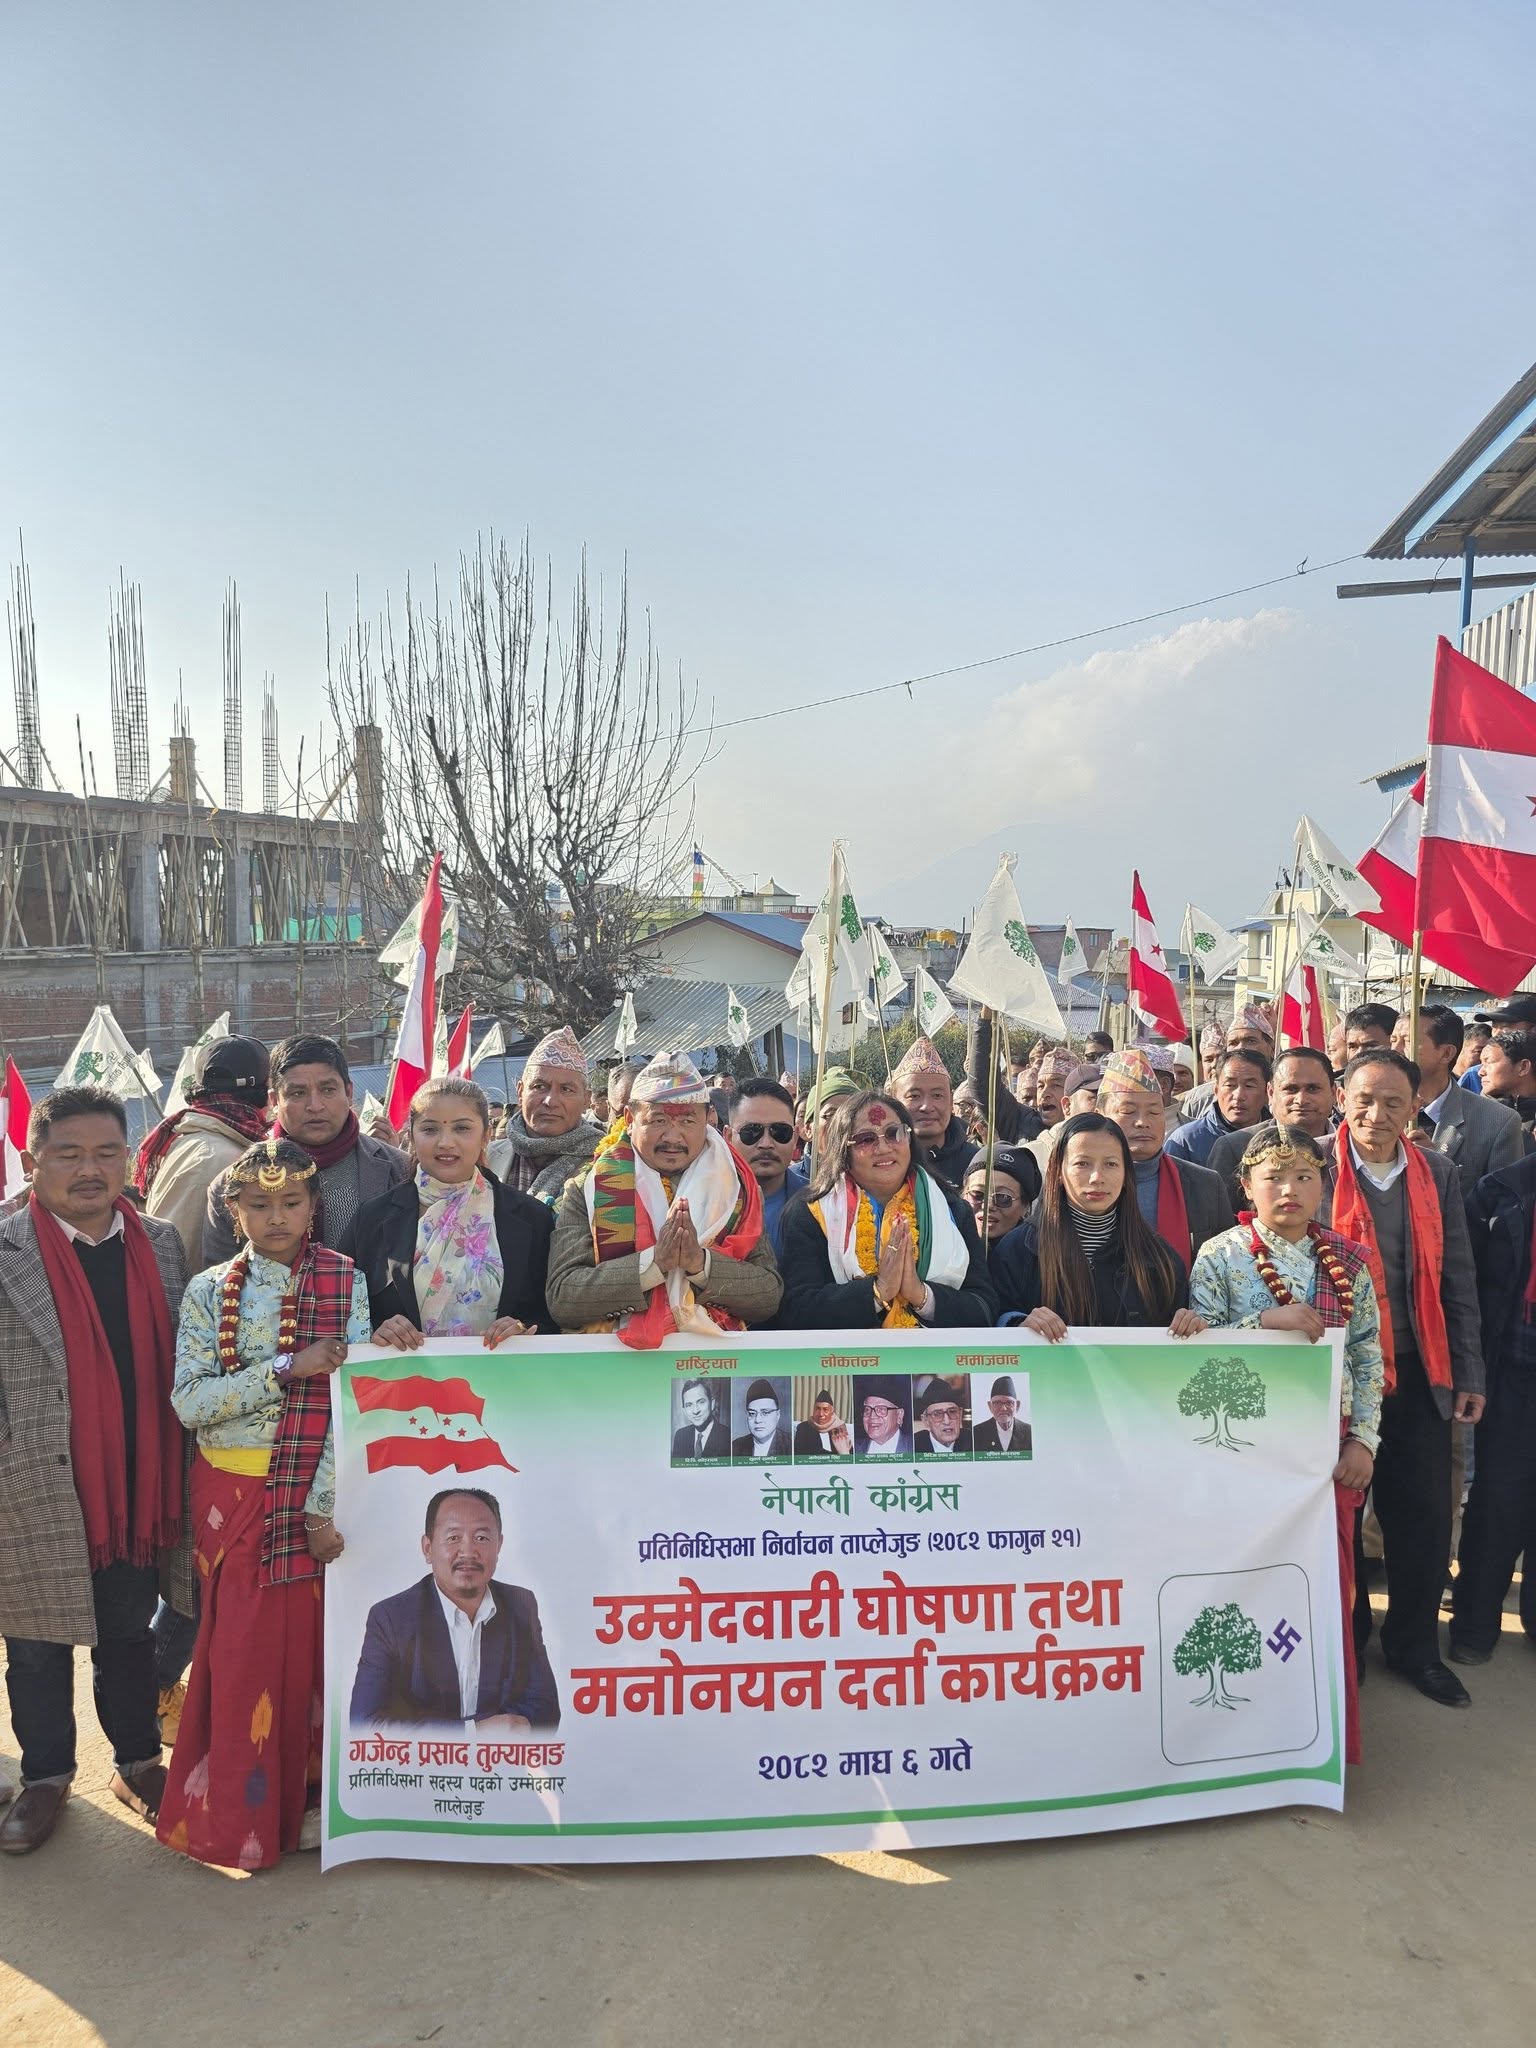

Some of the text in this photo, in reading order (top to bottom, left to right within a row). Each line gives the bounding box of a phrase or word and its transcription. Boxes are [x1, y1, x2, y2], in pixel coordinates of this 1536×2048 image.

[675, 1355, 738, 1376] राष्ट्रियता
[820, 1354, 881, 1368] लोकतन्त्र
[955, 1353, 1020, 1367] समाजवाद
[759, 1469, 963, 1517] नेपाली कांग्रेस
[638, 1527, 1081, 1564] प्रतिनिधिसभा निर्वाचन ताप्लेजुङ (२०८२ फागुन २१)
[592, 1570, 1124, 1645] उम्मेदवारी घोषणा तथा
[570, 1632, 1145, 1718] मनोनयन दर्ता कार्यक्रम
[349, 1732, 566, 1773] गजेन्द्र प्रसाद तुम्याहाङ
[758, 1737, 974, 1781] २०८२ माघ ६ गते
[348, 1767, 567, 1795] प्रतिनिधिसभा सदस्य पदको उम्मेदवार
[433, 1796, 486, 1820] ताप्लेजुङ
